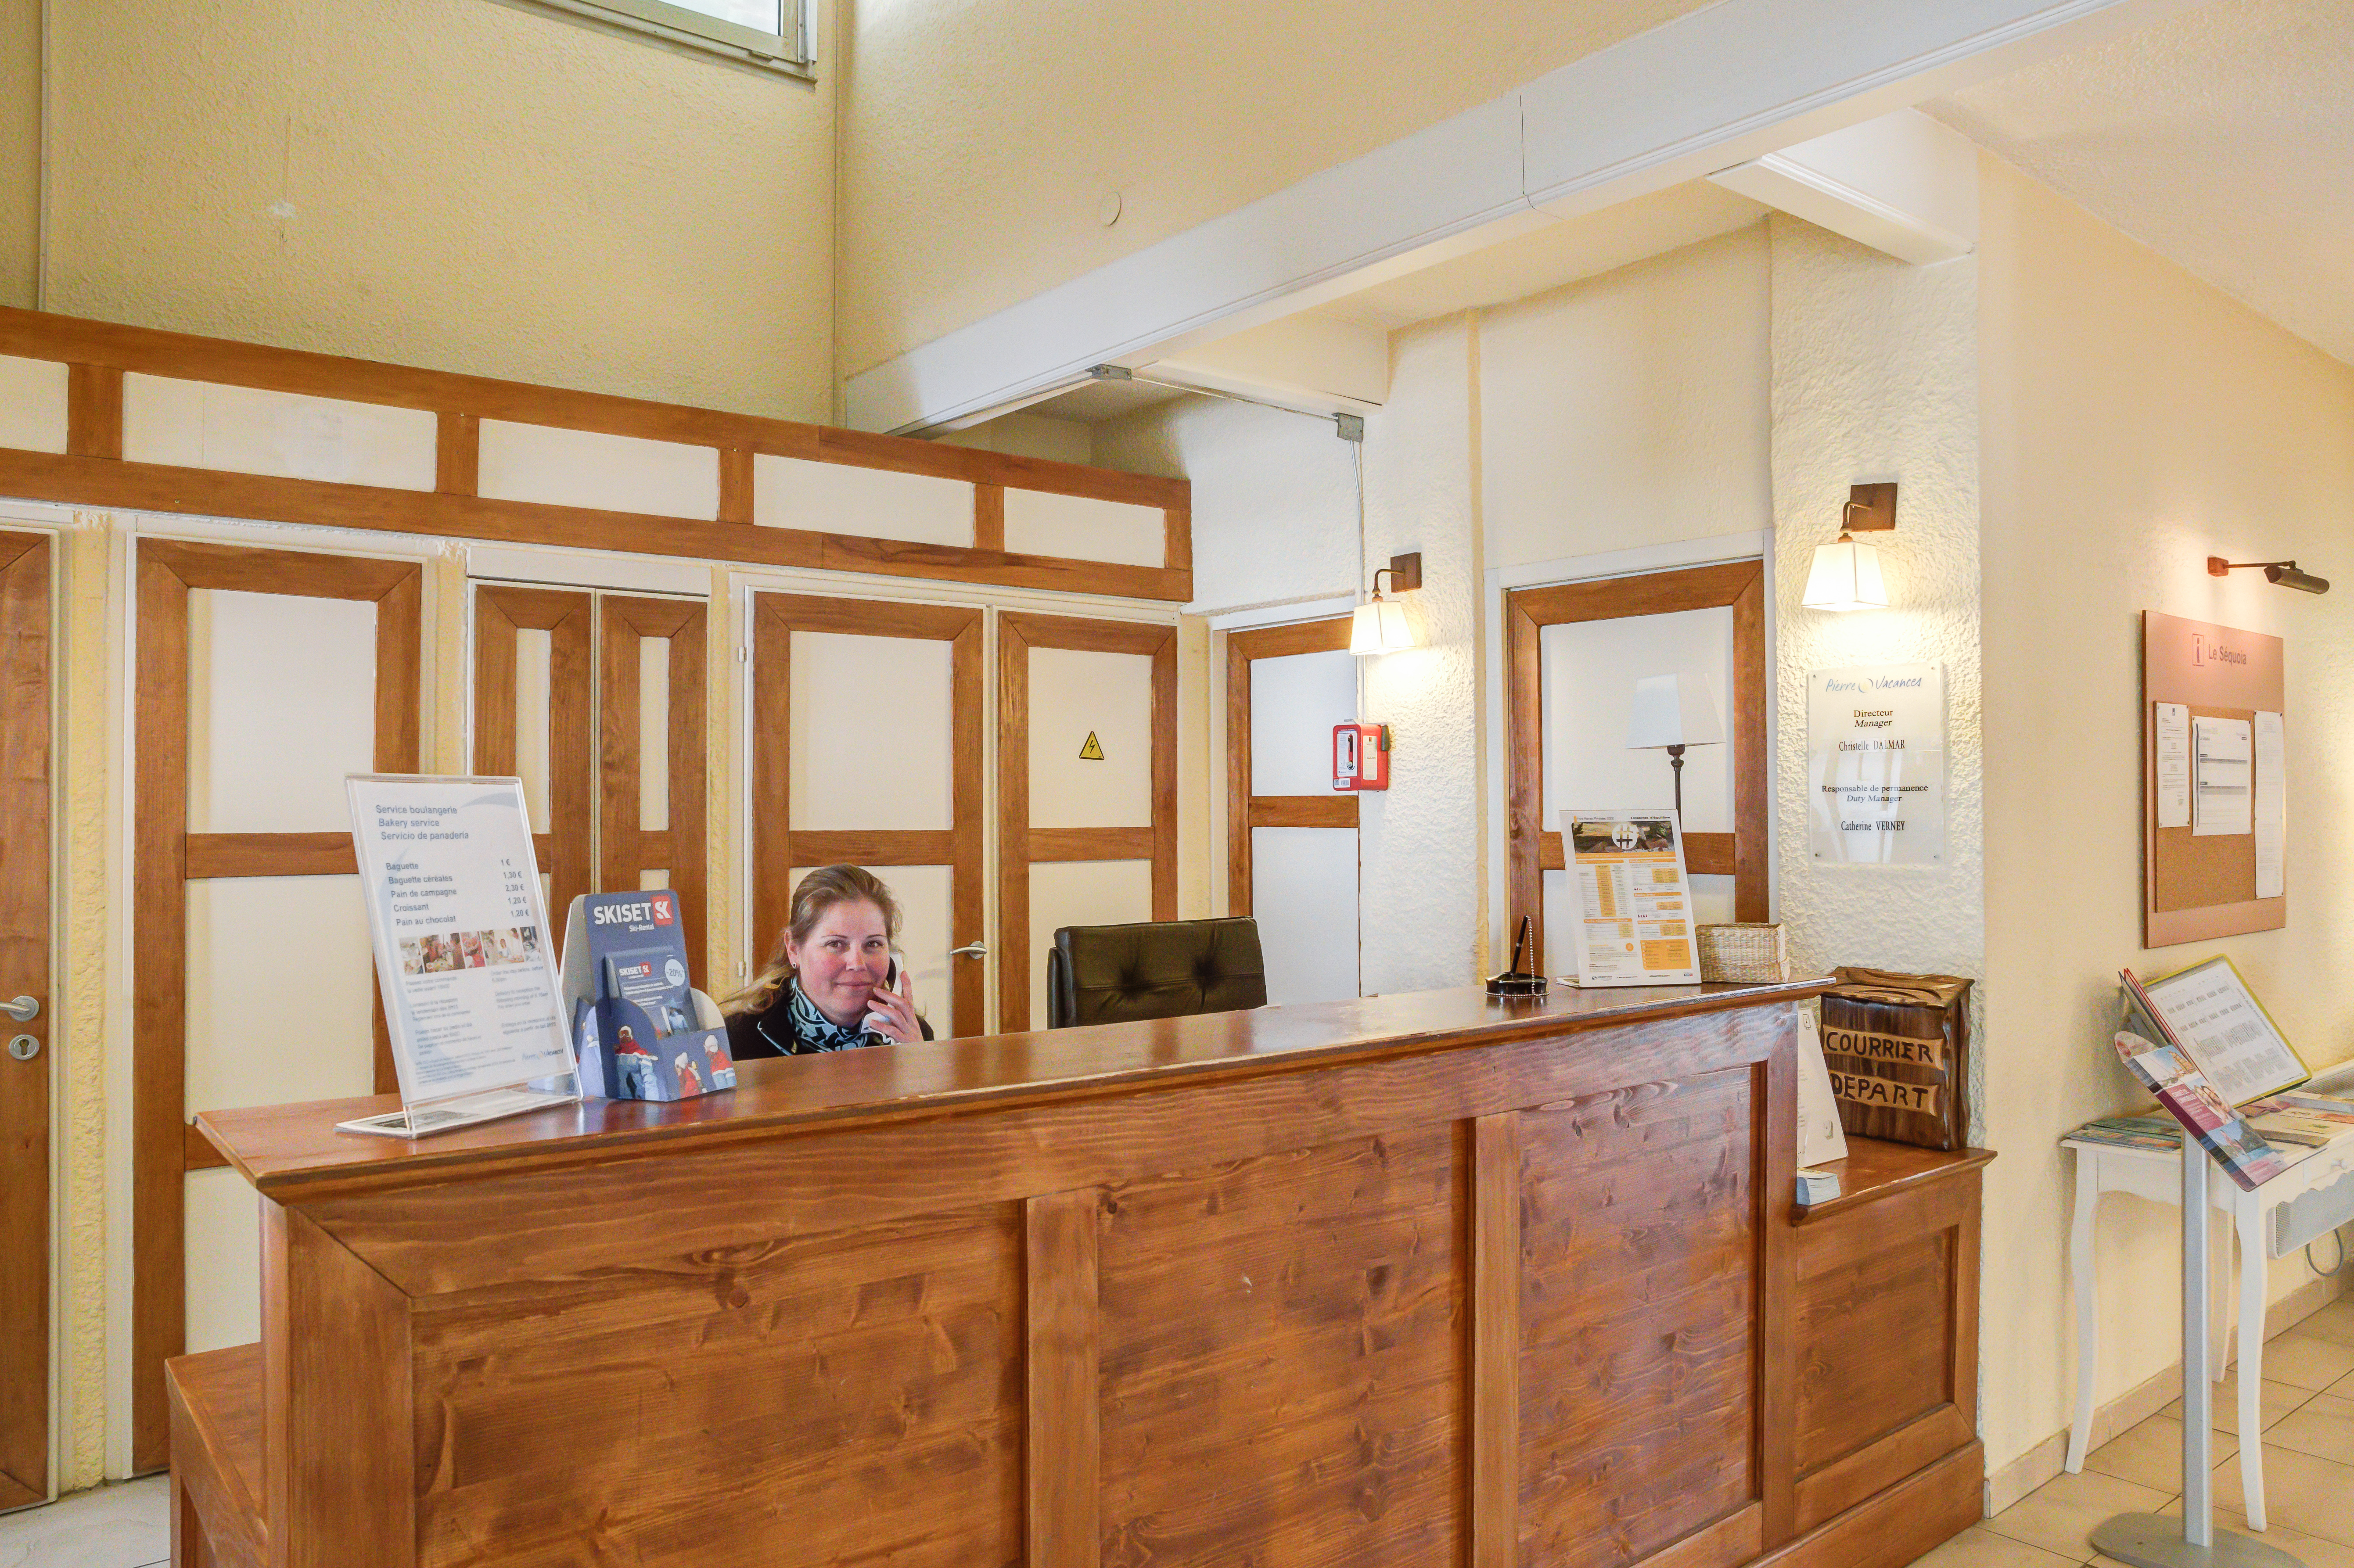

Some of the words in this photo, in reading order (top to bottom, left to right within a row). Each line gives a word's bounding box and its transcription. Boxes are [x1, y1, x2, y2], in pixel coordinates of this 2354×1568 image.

[2208, 644, 2217, 660] Le
[2219, 645, 2246, 667] Séquoia
[1826, 678, 1856, 692] Pierre
[1876, 675, 1922, 689] Vacances
[1854, 720, 1893, 728] Manager
[1839, 740, 1869, 751] Christelle
[1873, 739, 1905, 750] DALMAR
[1822, 785, 1868, 793] Responsable
[1847, 795, 1865, 804] Duty
[1868, 795, 1902, 804] Manager
[376, 805, 407, 813] Service
[409, 805, 457, 815] boulangerie
[379, 818, 407, 828] Bakery
[1841, 821, 1872, 831] Catherine
[1876, 821, 1905, 831] VERNEY
[386, 863, 419, 871] Baguette
[388, 876, 421, 885] Baguette
[394, 904, 429, 912] Croissant
[594, 902, 651, 925] SKISET
[426, 915, 456, 924] chocolat
[629, 923, 654, 932] Ski-Rental
[619, 966, 642, 976] SKISET
[1826, 1031, 1933, 1063] COURRIER
[1829, 1073, 1928, 1109] DEPART
